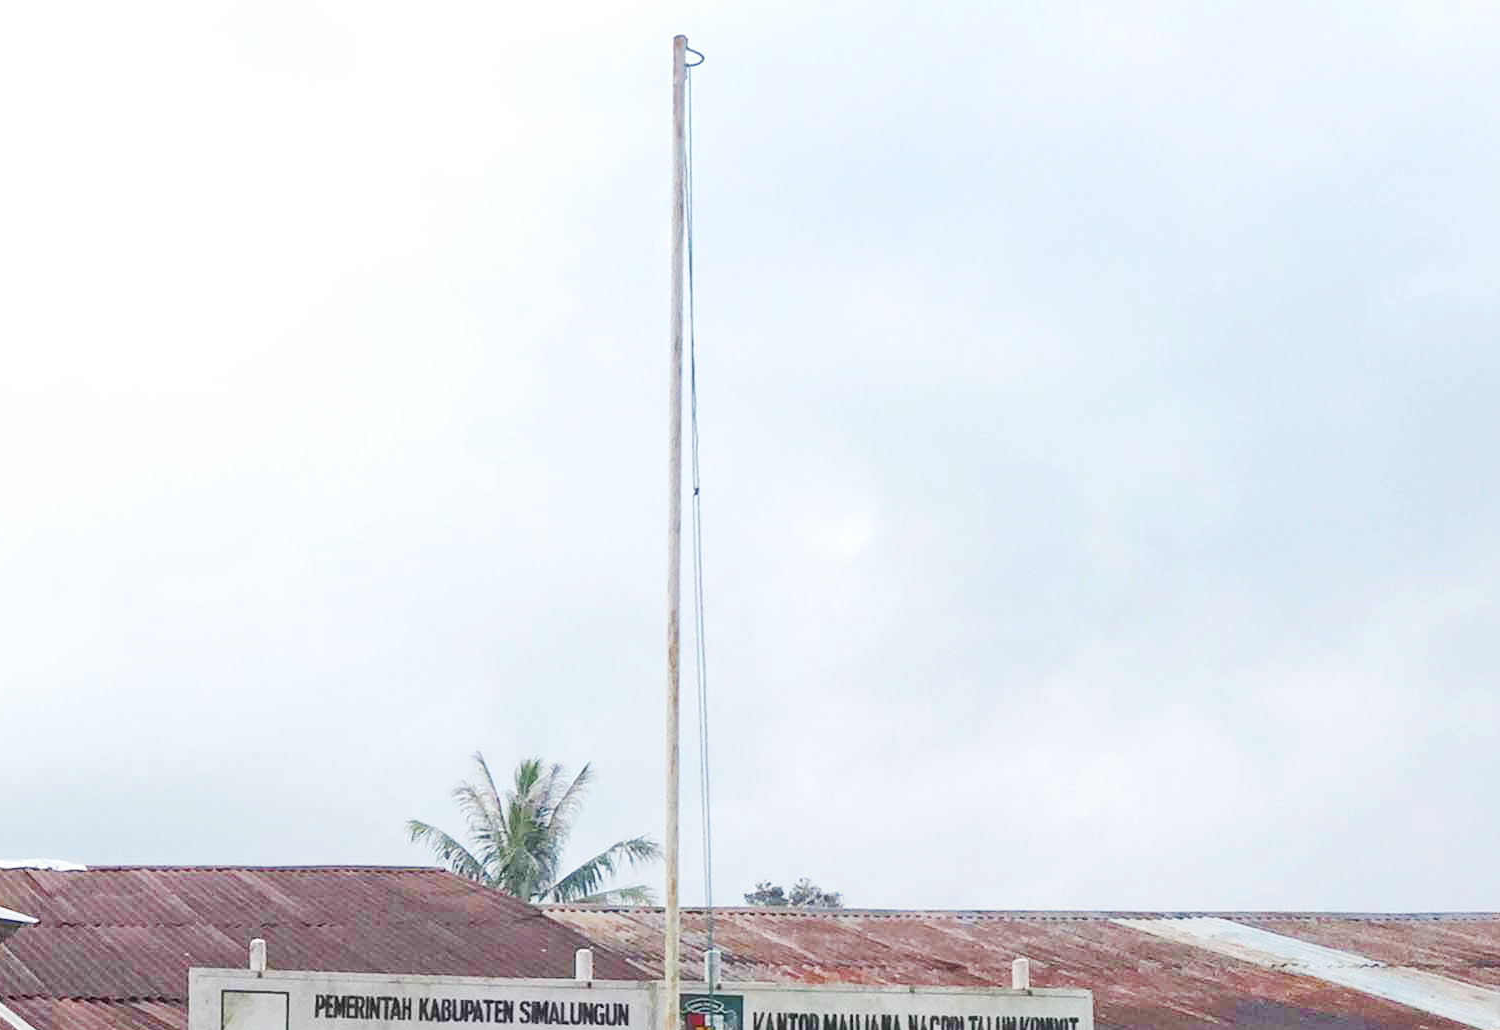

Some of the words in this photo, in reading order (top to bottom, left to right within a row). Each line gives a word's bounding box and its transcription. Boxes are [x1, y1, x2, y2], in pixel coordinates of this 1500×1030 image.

[314, 994, 412, 1020] PEMERINTAH
[418, 997, 514, 1024] KABUPATEN
[519, 1000, 629, 1026] SIMALUNGUN
